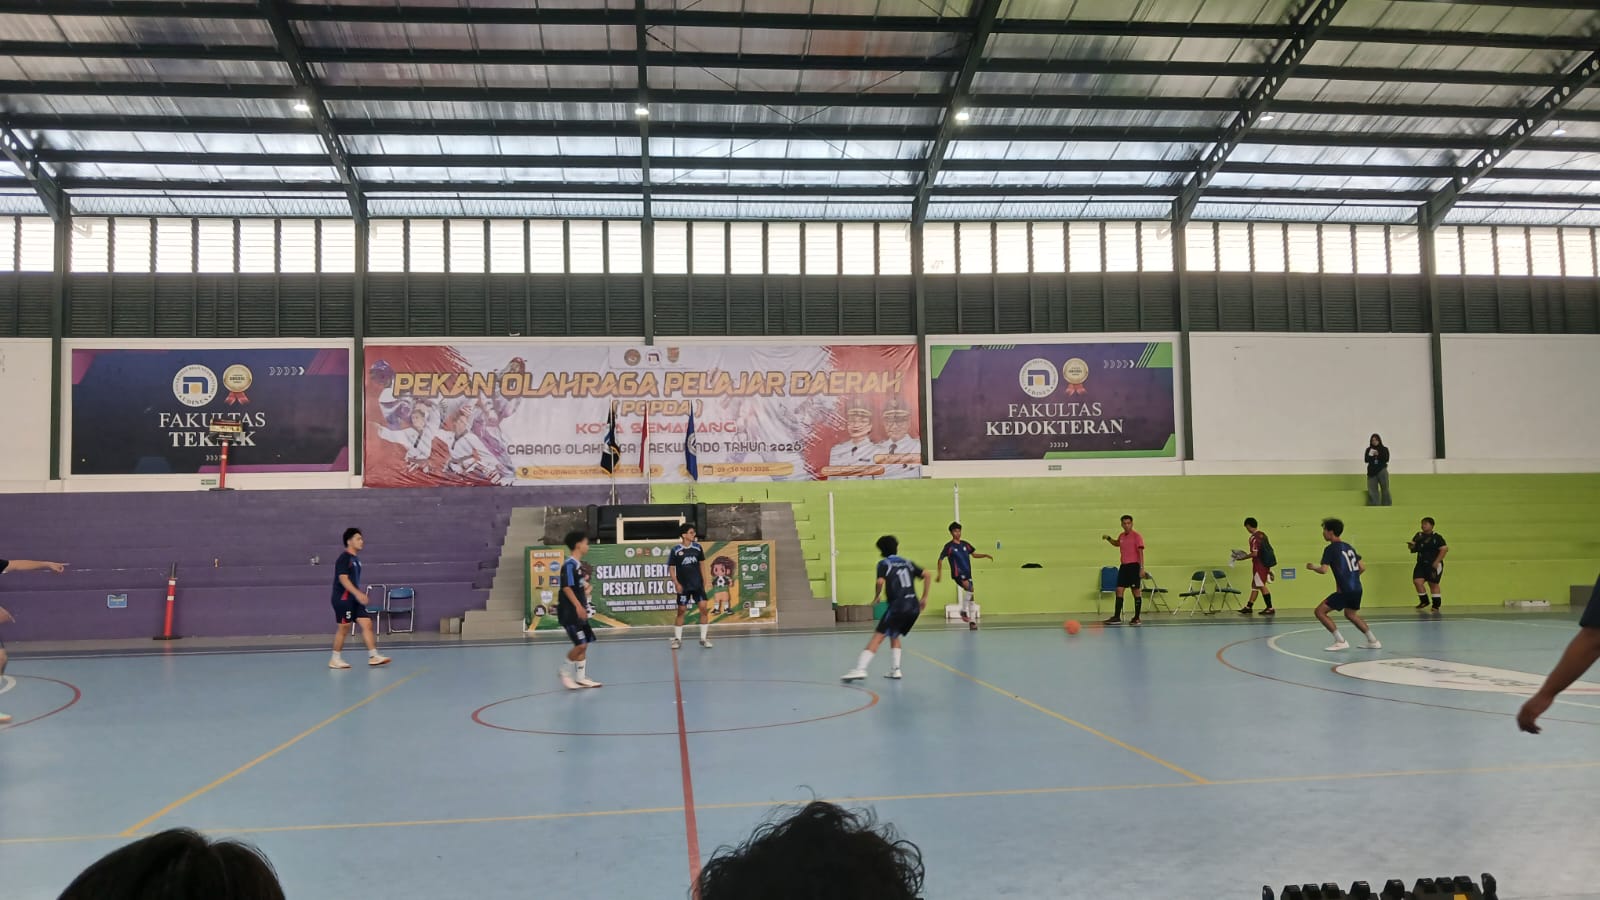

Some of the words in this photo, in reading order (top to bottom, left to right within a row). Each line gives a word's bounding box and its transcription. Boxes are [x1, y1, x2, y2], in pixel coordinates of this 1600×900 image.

[393, 372, 495, 398] PEKAN
[500, 372, 660, 398] OLAHRAGA
[664, 371, 785, 397] PELAJAR
[790, 371, 903, 396] DAERAH
[621, 400, 690, 416] POPDA
[1008, 402, 1102, 417] FAKULTAS
[576, 423, 624, 434] KOA
[631, 422, 737, 434] SEMAANG
[986, 419, 1124, 436] KEDOKTERAN
[168, 431, 256, 447] TEKK
[507, 443, 562, 455] CABANG
[565, 443, 636, 455] OLAHGA
[638, 442, 720, 454] AEKWNDO
[724, 441, 767, 452] TAHUN
[770, 440, 802, 452] 2026
[1341, 549, 1359, 572] 12
[596, 564, 642, 579] SELAMAT
[896, 568, 912, 588] 11
[602, 581, 645, 596] PESERTA
[648, 581, 664, 594] FIX
[345, 611, 352, 619] 5
